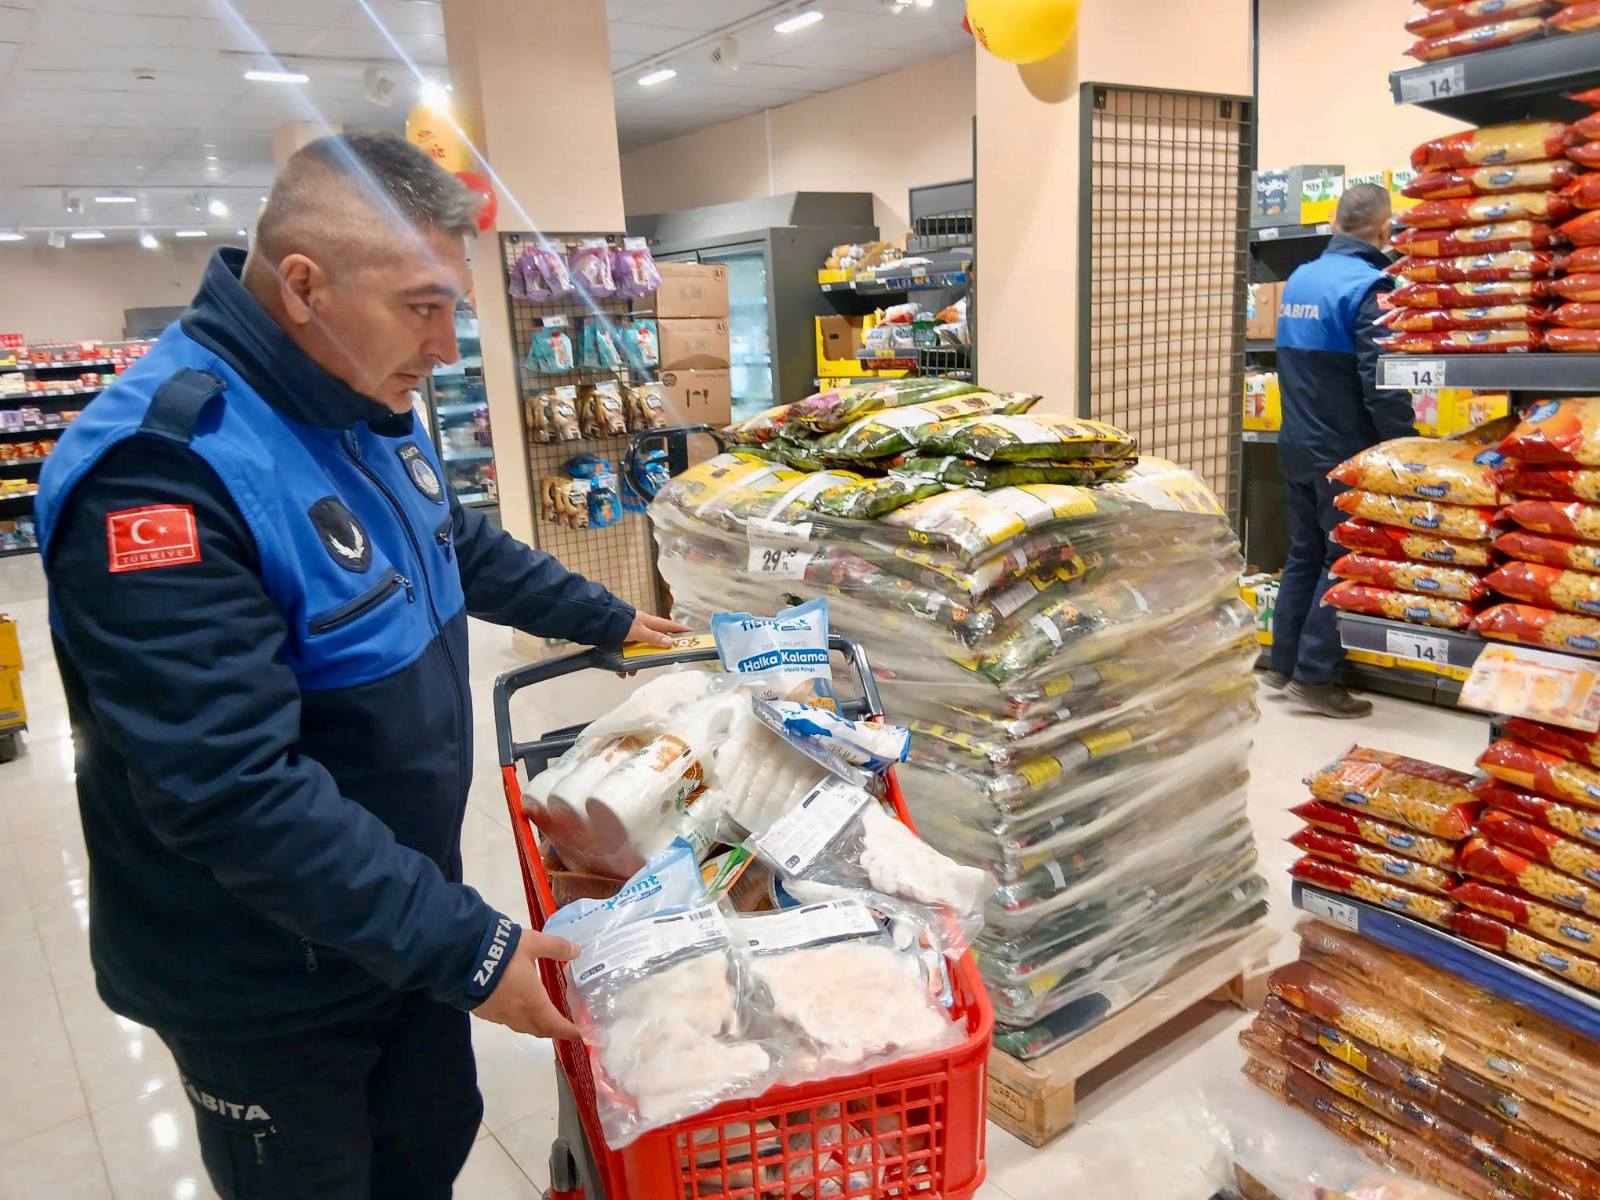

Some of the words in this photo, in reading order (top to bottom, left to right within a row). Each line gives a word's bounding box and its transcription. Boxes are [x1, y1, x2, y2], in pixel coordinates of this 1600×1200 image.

[1430, 78, 1452, 97] 14
[1412, 370, 1433, 386] 14
[1414, 644, 1435, 660] 14
[743, 655, 779, 673] Halka
[473, 918, 514, 987] ZABITA
[182, 1075, 272, 1120] BITA
